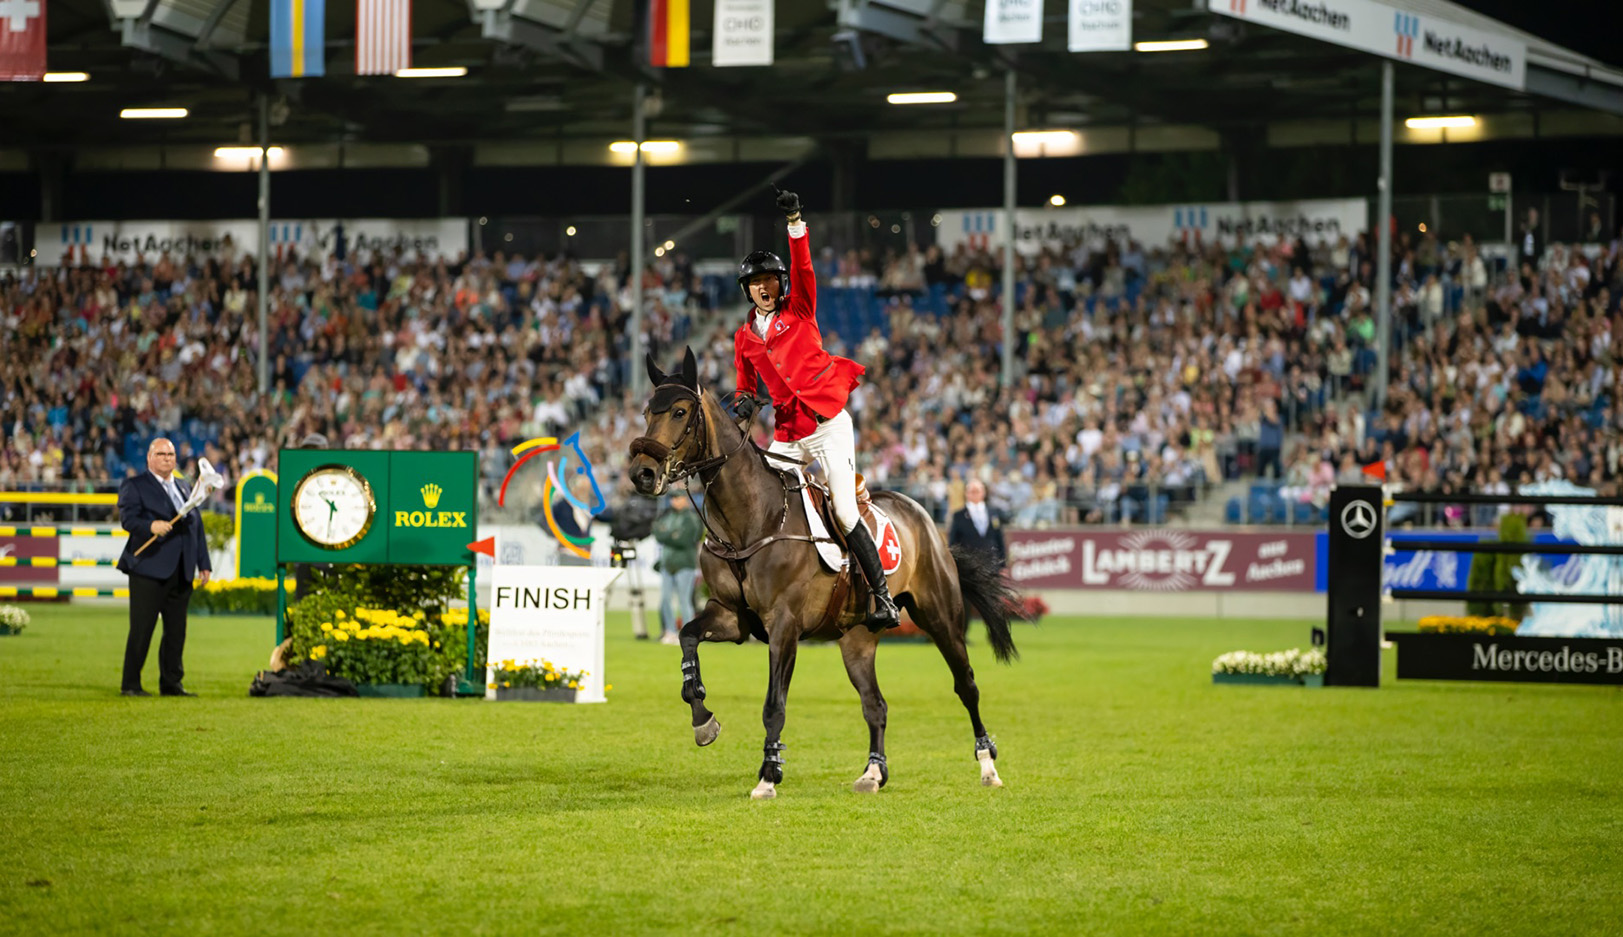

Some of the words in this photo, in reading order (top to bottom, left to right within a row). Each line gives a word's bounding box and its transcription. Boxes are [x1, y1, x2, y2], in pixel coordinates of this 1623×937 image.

[1423, 28, 1512, 74] NetAachen
[1217, 212, 1340, 234] NetAachen
[395, 511, 467, 528] ROLEX
[1082, 540, 1236, 586] LAMBERTZ
[496, 586, 591, 610] FINISH
[1472, 642, 1623, 674] Mercedes-B
